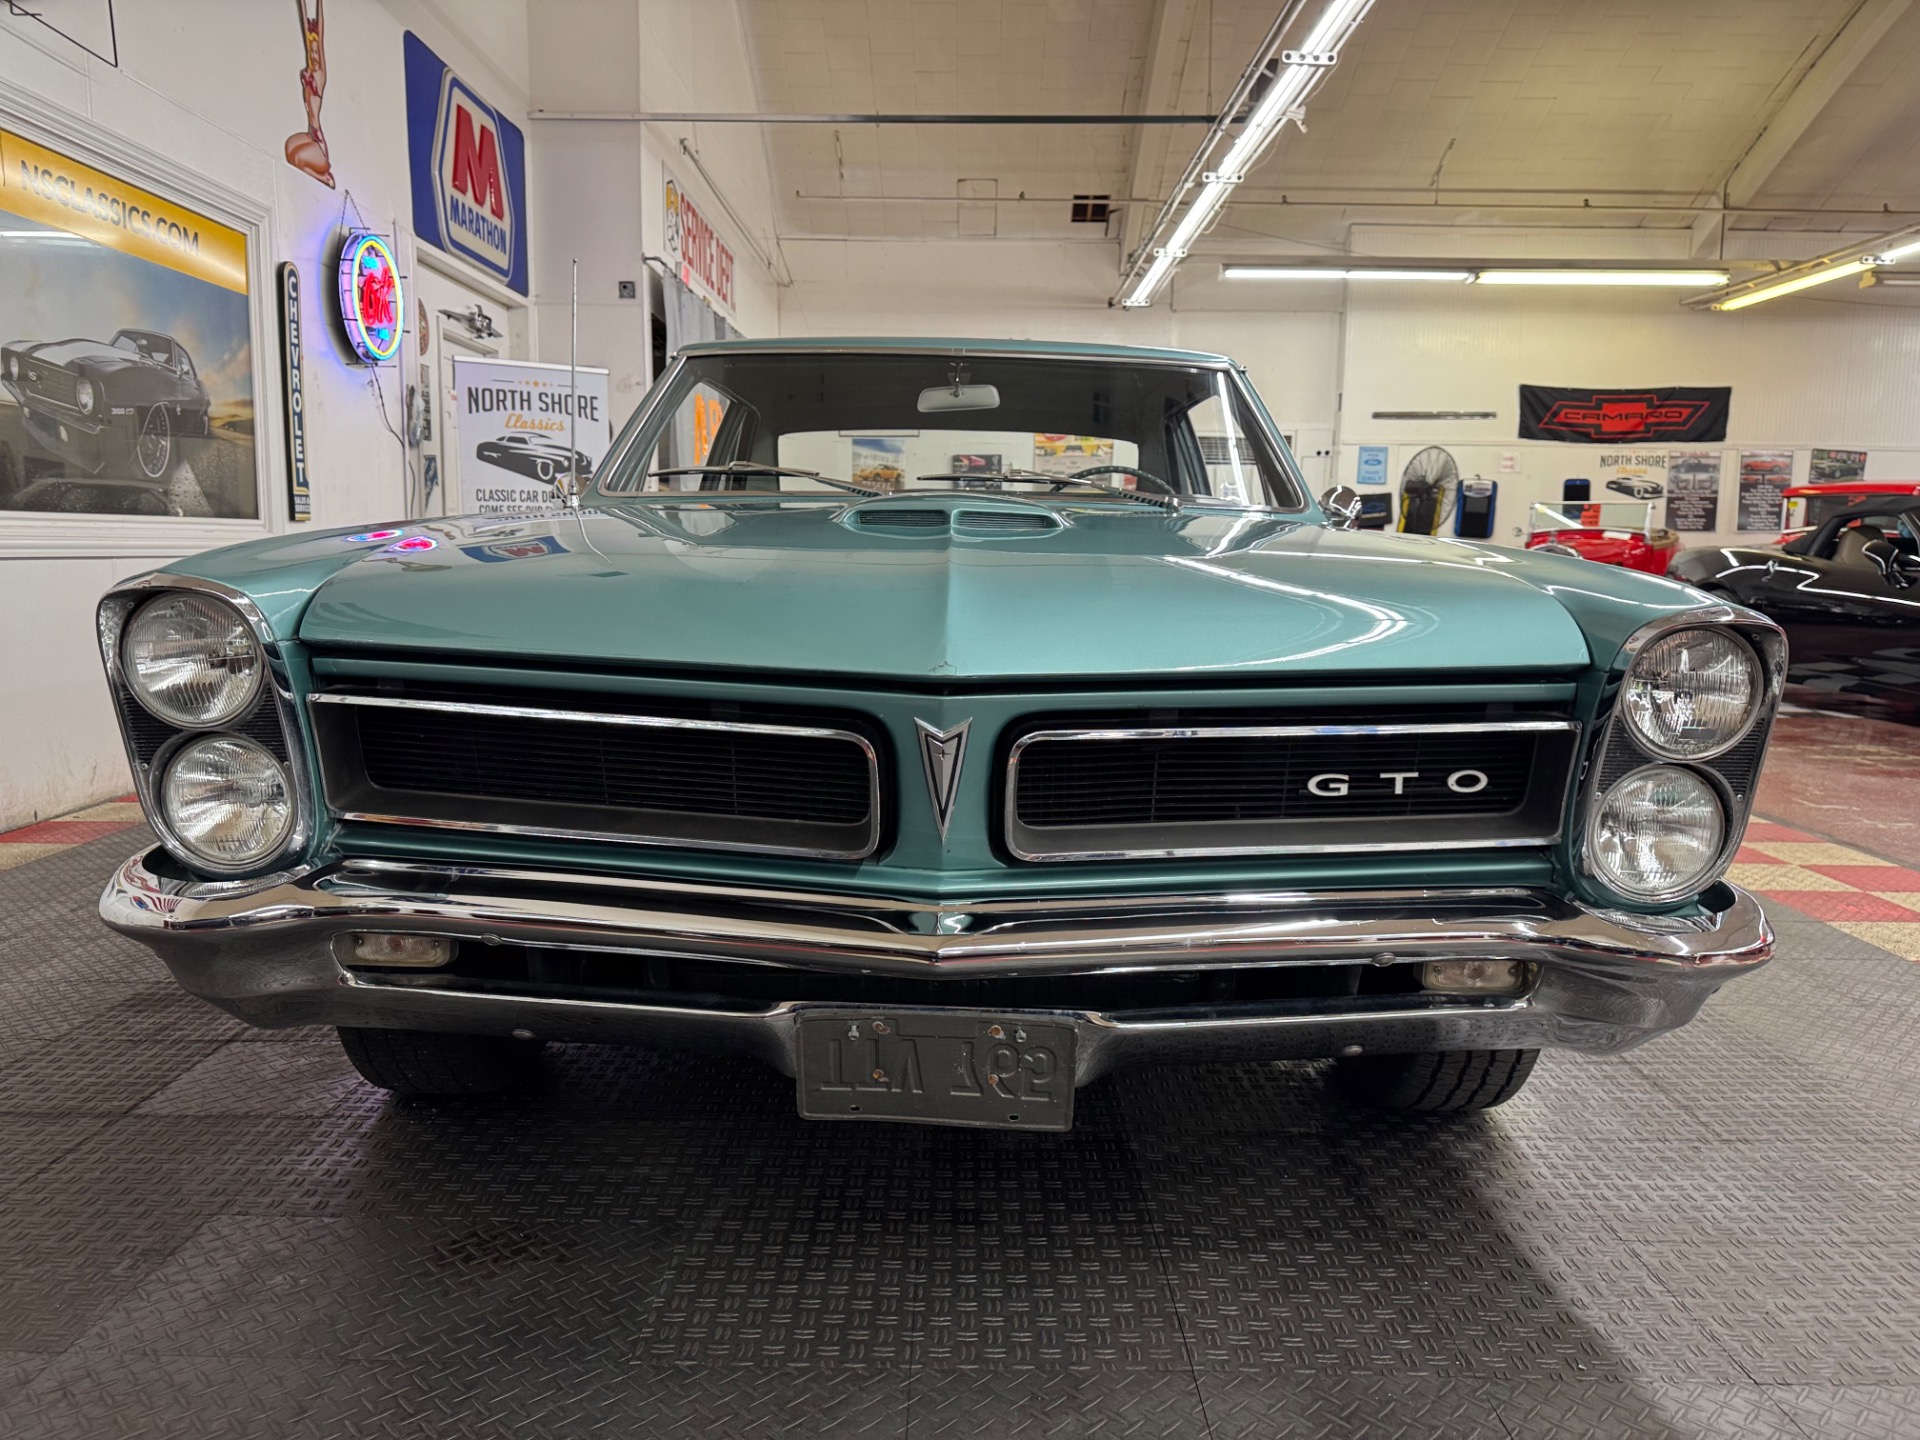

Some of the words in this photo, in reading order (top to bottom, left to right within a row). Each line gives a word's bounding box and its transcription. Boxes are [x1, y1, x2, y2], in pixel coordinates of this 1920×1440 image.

[20, 159, 199, 254] NSCLASSICS.COM
[450, 194, 507, 255] MARATHON
[287, 276, 305, 482] CHEVROLET
[467, 386, 531, 414] NORTH
[538, 392, 599, 422] SHORE
[1563, 409, 1683, 421] CAMARO
[504, 413, 566, 432] Classics
[1600, 455, 1632, 468] NORTH
[1634, 455, 1667, 469] SHORE
[476, 488, 516, 502] CLASSIC
[519, 489, 539, 503] CAR
[1307, 769, 1488, 797] GTO
